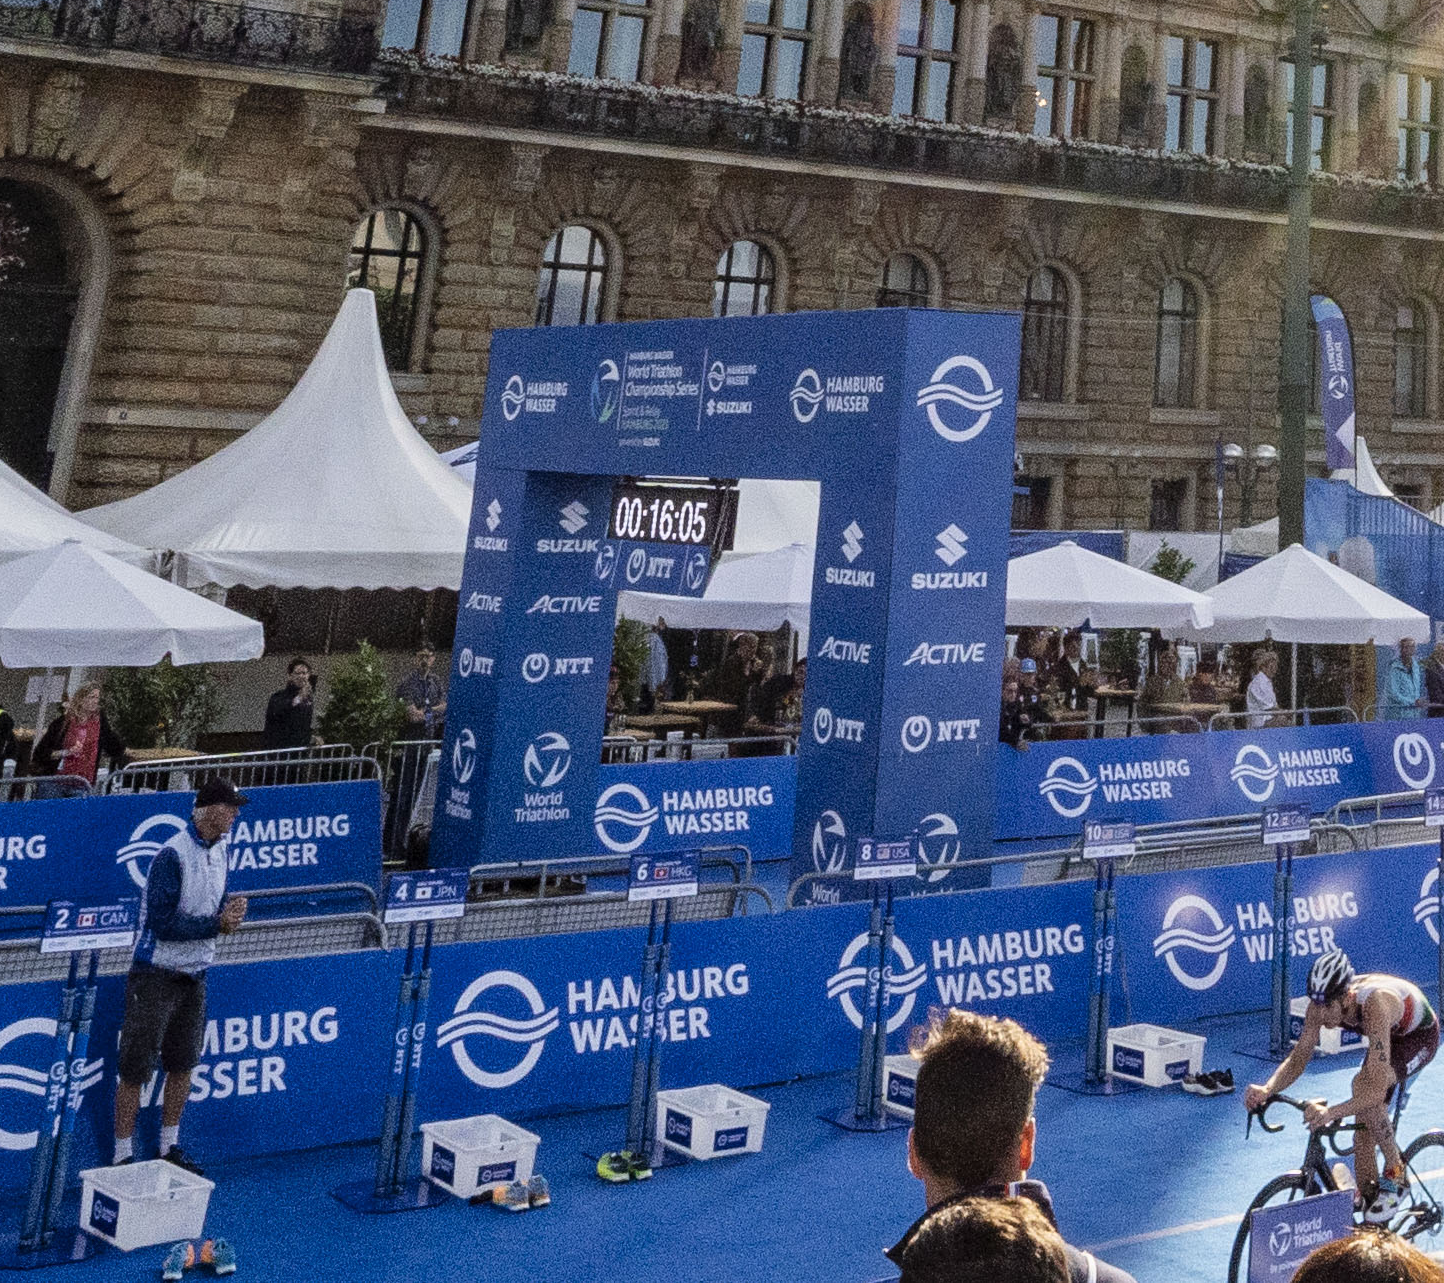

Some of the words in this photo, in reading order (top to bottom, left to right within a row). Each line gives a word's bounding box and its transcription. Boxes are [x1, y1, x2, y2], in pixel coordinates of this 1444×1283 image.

[526, 381, 568, 397] HAMBURG
[826, 375, 884, 393] HAMBURG
[826, 395, 869, 413] WASSER
[615, 497, 708, 543] 00:16:05
[646, 557, 675, 579] NTT
[824, 567, 875, 589] SUZUKI
[911, 571, 988, 590] SUZUKI
[465, 591, 502, 613] ACTIVE
[526, 594, 603, 615] ACTIVE
[818, 635, 872, 664] ACTIVE
[903, 641, 987, 666] ACTIVE
[473, 657, 494, 675] NTT
[554, 657, 594, 675] NTT
[835, 717, 866, 743] NTT
[936, 719, 980, 743] NTT
[1278, 747, 1354, 769] HAMBURG
[1099, 759, 1191, 782] HAMBURG
[1283, 766, 1341, 788] WASSER
[524, 791, 563, 807] World
[662, 785, 774, 812] HAMBURG
[1102, 780, 1174, 804] WASSER
[1427, 797, 1440, 811] 14
[514, 807, 570, 824] Triathlon
[664, 810, 750, 836] WASSER
[1266, 813, 1279, 827] 12
[1086, 825, 1101, 841] 10
[860, 843, 872, 861] 8
[891, 847, 910, 859] USA
[636, 862, 648, 881] 6
[395, 883, 408, 901] 4
[434, 885, 456, 897] JPN
[55, 909, 68, 929] 2
[100, 912, 129, 925] CAN
[1236, 891, 1358, 931] HABURG
[932, 923, 1085, 970] HAMBURG
[936, 963, 1055, 1005] WASSER
[200, 1007, 339, 1057] MBURG
[1294, 1217, 1322, 1235] World
[1292, 1230, 1333, 1249] Triathlon
